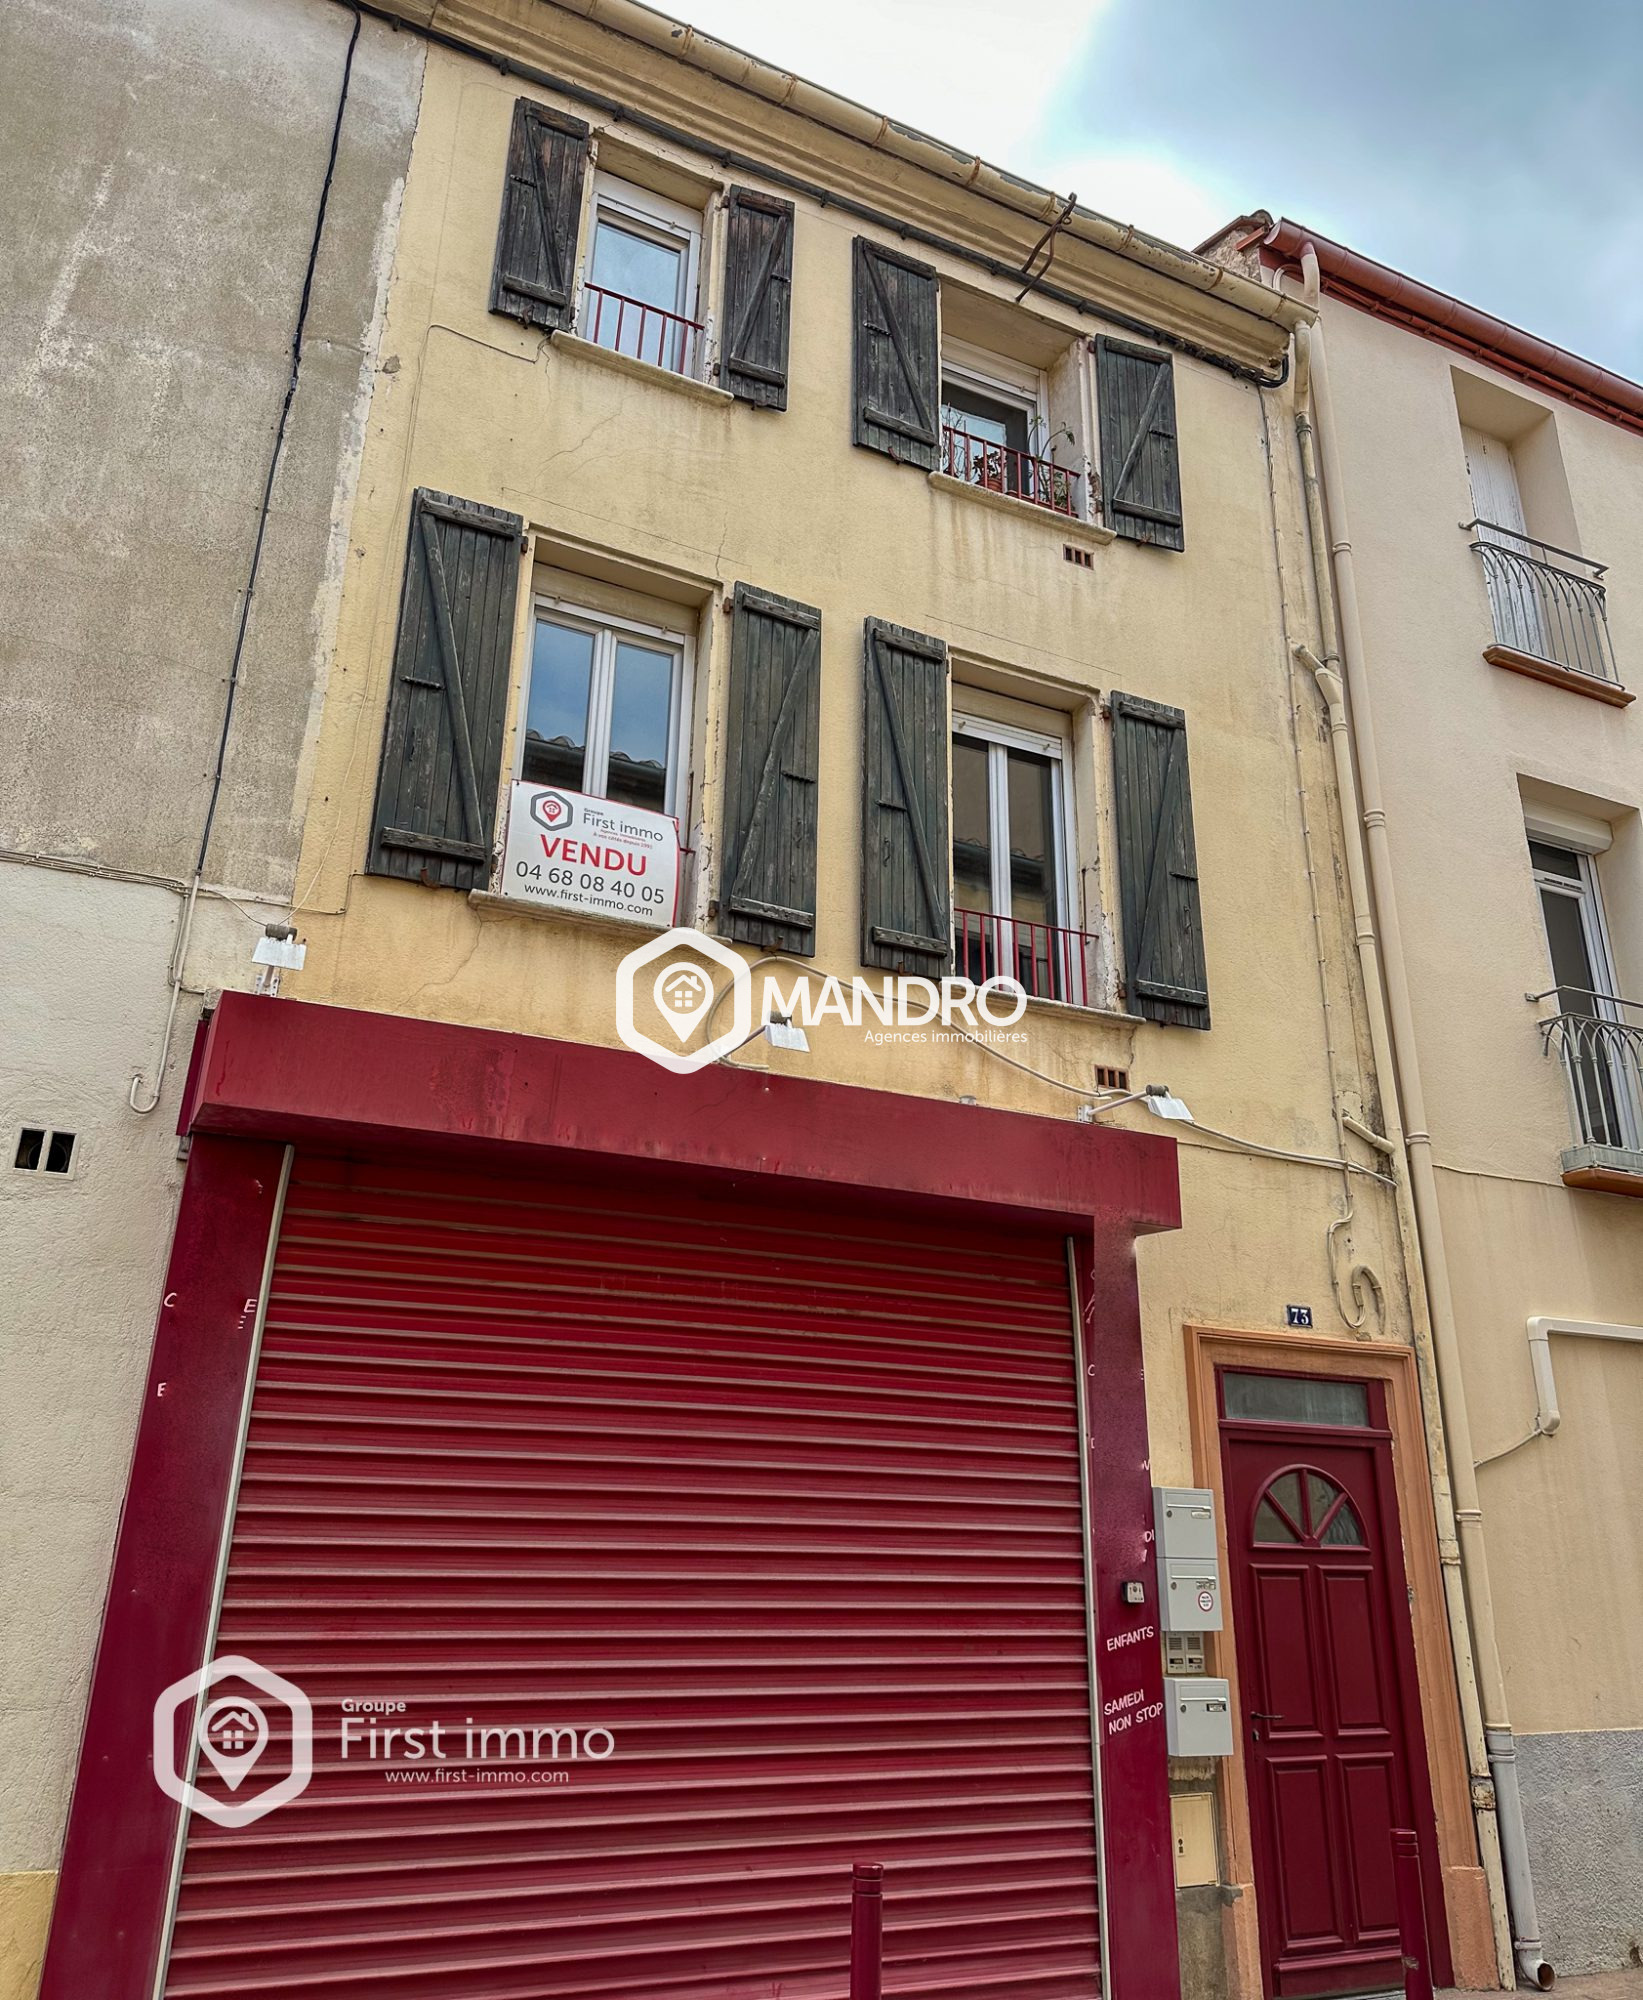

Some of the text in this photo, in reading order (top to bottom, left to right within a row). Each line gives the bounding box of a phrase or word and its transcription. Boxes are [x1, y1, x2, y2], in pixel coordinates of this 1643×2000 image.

[583, 812, 663, 841] First immo
[540, 833, 647, 876] VENDU
[516, 861, 664, 904] 04 68 08 40 05
[524, 883, 653, 916] www.first-immo.com
[1291, 1308, 1309, 1324] 73
[1106, 1625, 1154, 1652] ENFANTS
[1103, 1688, 1145, 1716] SAMEDI
[1108, 1702, 1163, 1735] NON STOP
